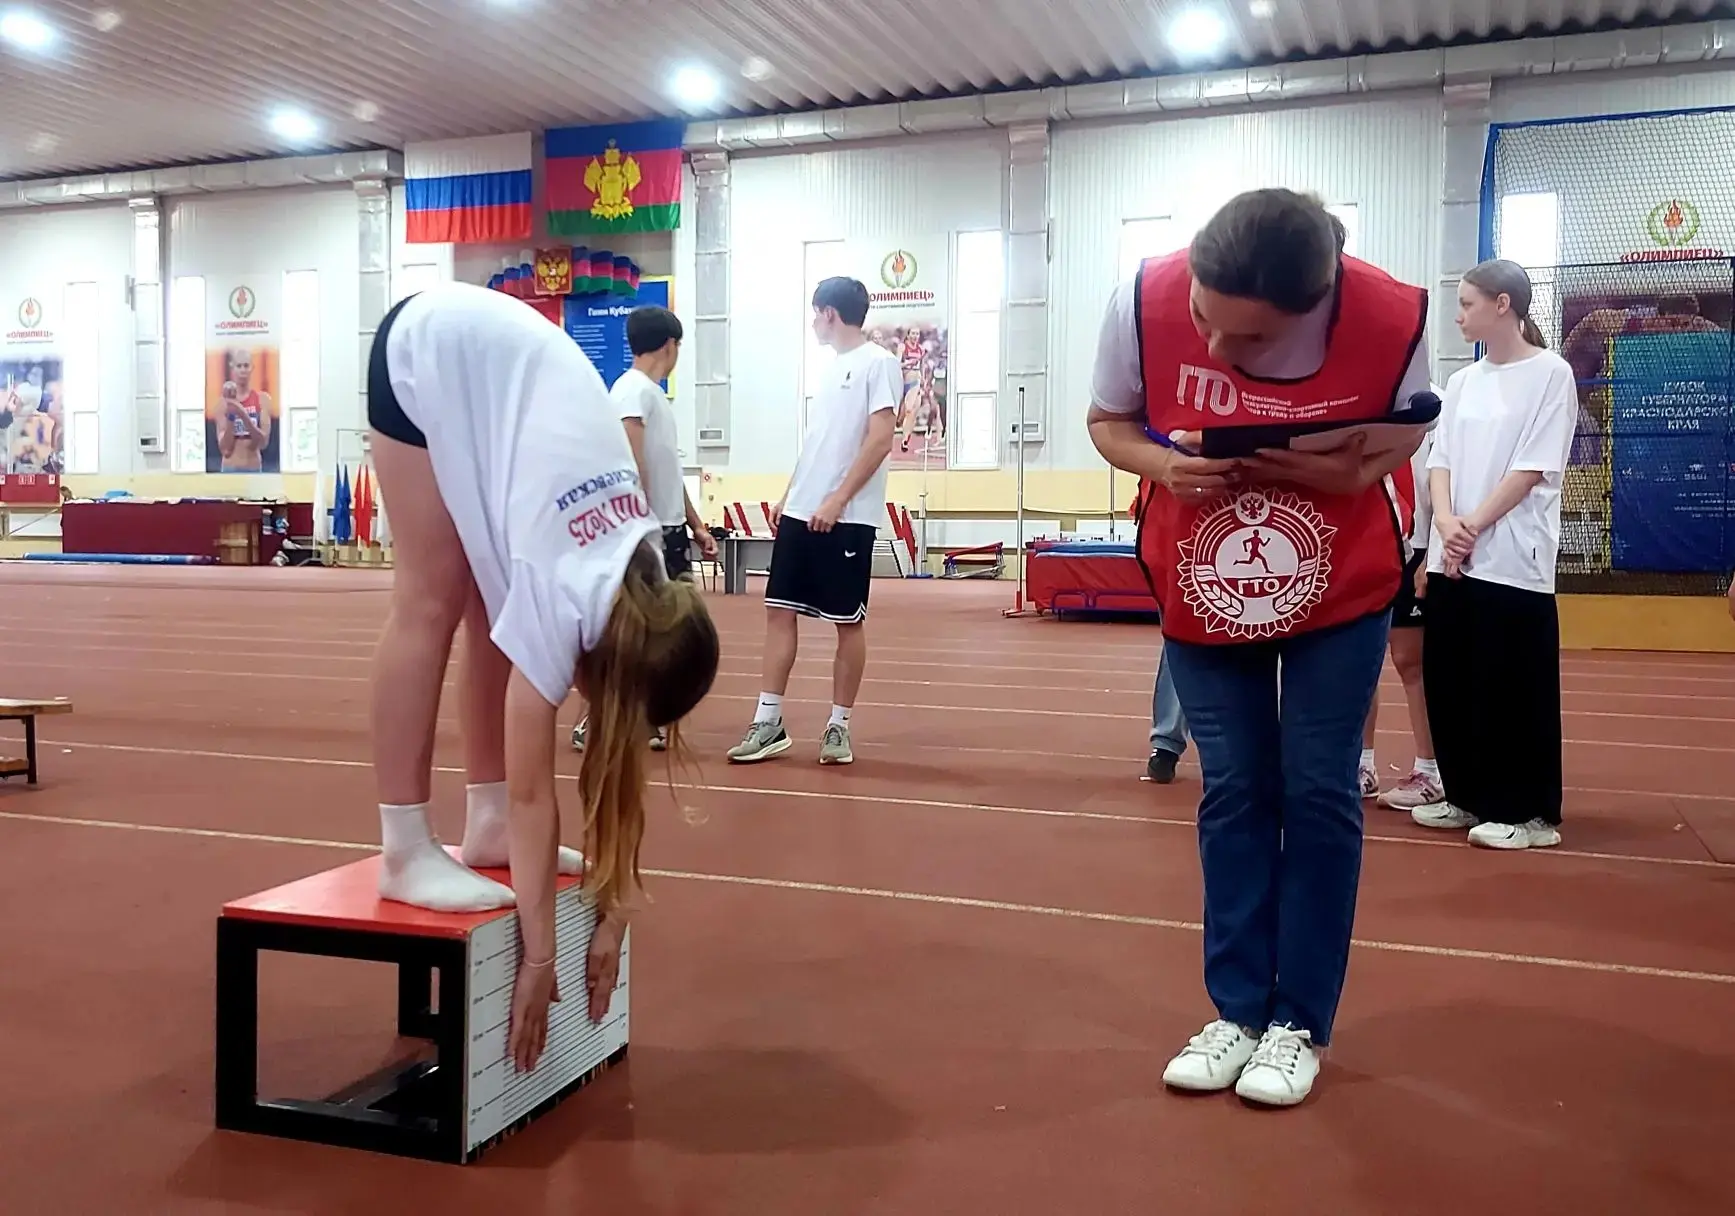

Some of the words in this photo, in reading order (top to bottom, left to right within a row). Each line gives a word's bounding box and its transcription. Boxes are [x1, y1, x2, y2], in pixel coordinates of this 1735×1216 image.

[869, 290, 935, 302] ОЛИМПИЕЦ»
[609, 305, 633, 317] Куба
[1177, 363, 1237, 416] ГТО
[1238, 578, 1280, 594] ГТО
